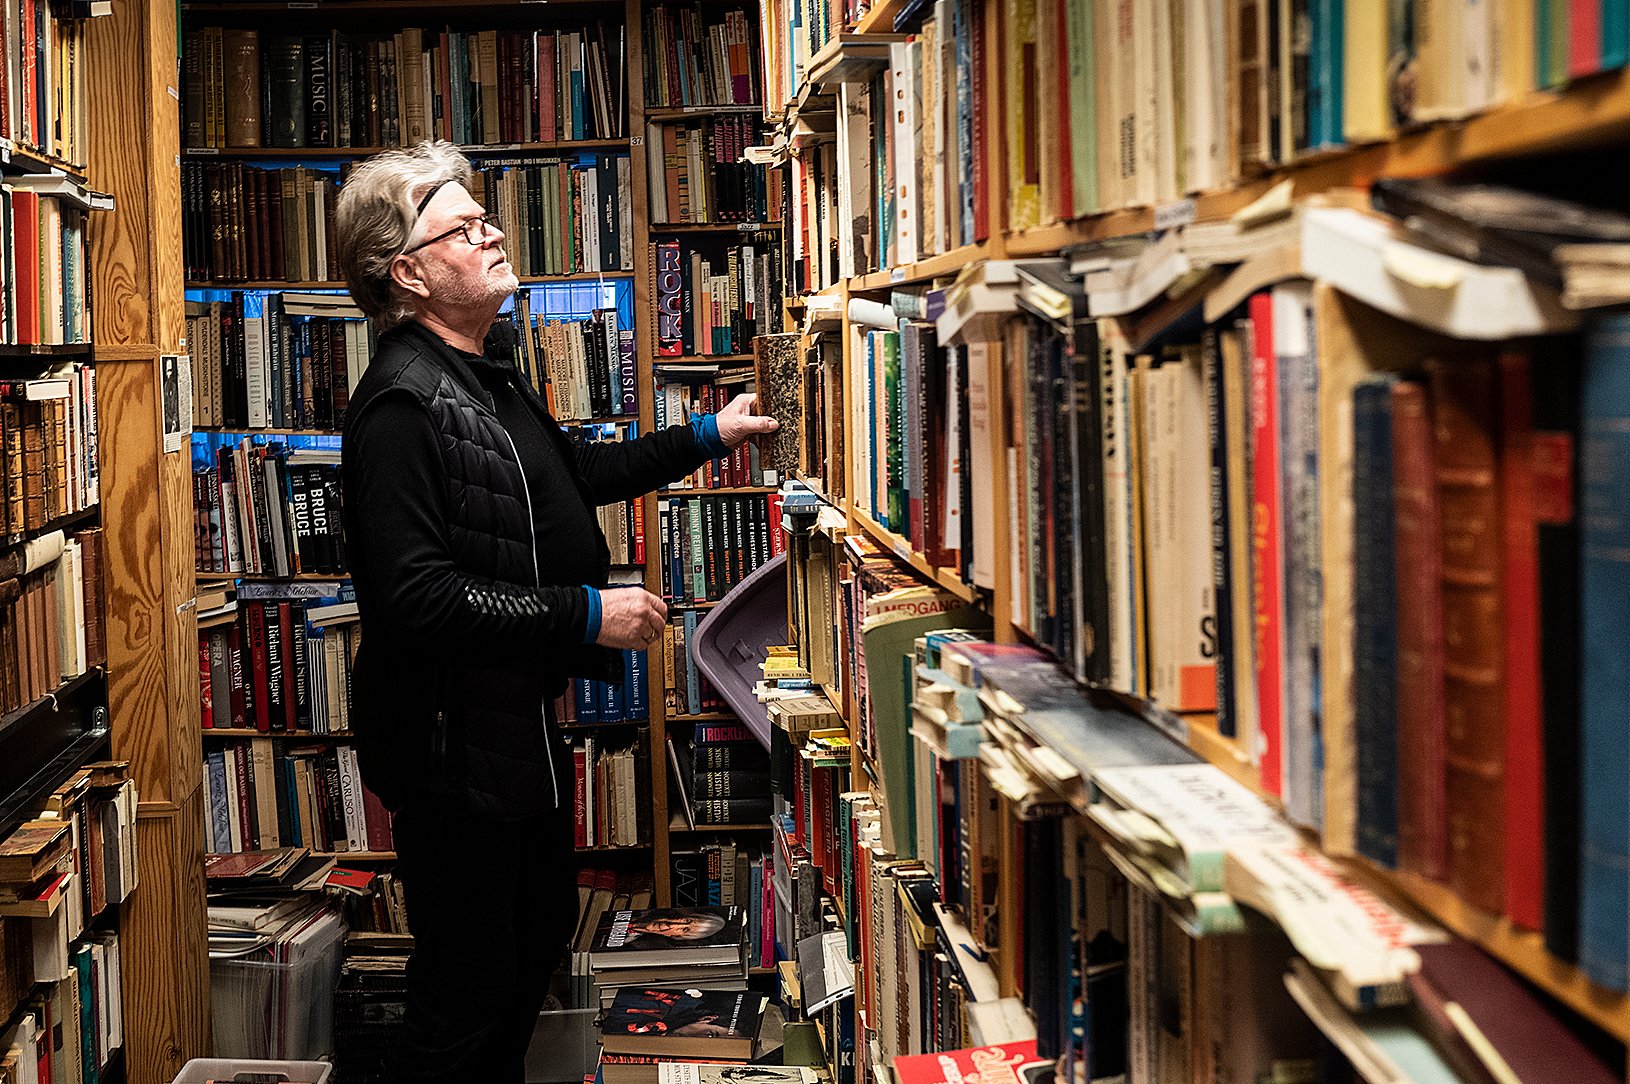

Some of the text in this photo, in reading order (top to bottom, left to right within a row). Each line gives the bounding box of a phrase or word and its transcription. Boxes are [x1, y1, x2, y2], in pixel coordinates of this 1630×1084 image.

[311, 56, 326, 112] MUSIC
[631, 137, 642, 145] 37
[658, 248, 682, 338] ROCK
[621, 352, 635, 404] MUSIC
[210, 474, 218, 510] UNMASKED
[310, 488, 328, 535] BRUCE
[227, 491, 237, 546] MADONNA
[294, 493, 311, 537] BRUCE
[691, 505, 700, 532] JOHNNY
[884, 599, 961, 616] MEDGANG
[212, 633, 222, 667] OPERA
[232, 649, 242, 689] WAGNER
[268, 624, 281, 704] Richard Wagner
[294, 624, 307, 705] Richard Strauss
[341, 774, 354, 814] CARUSO
[714, 772, 722, 797] MUSIK
[614, 910, 633, 922] LISE
